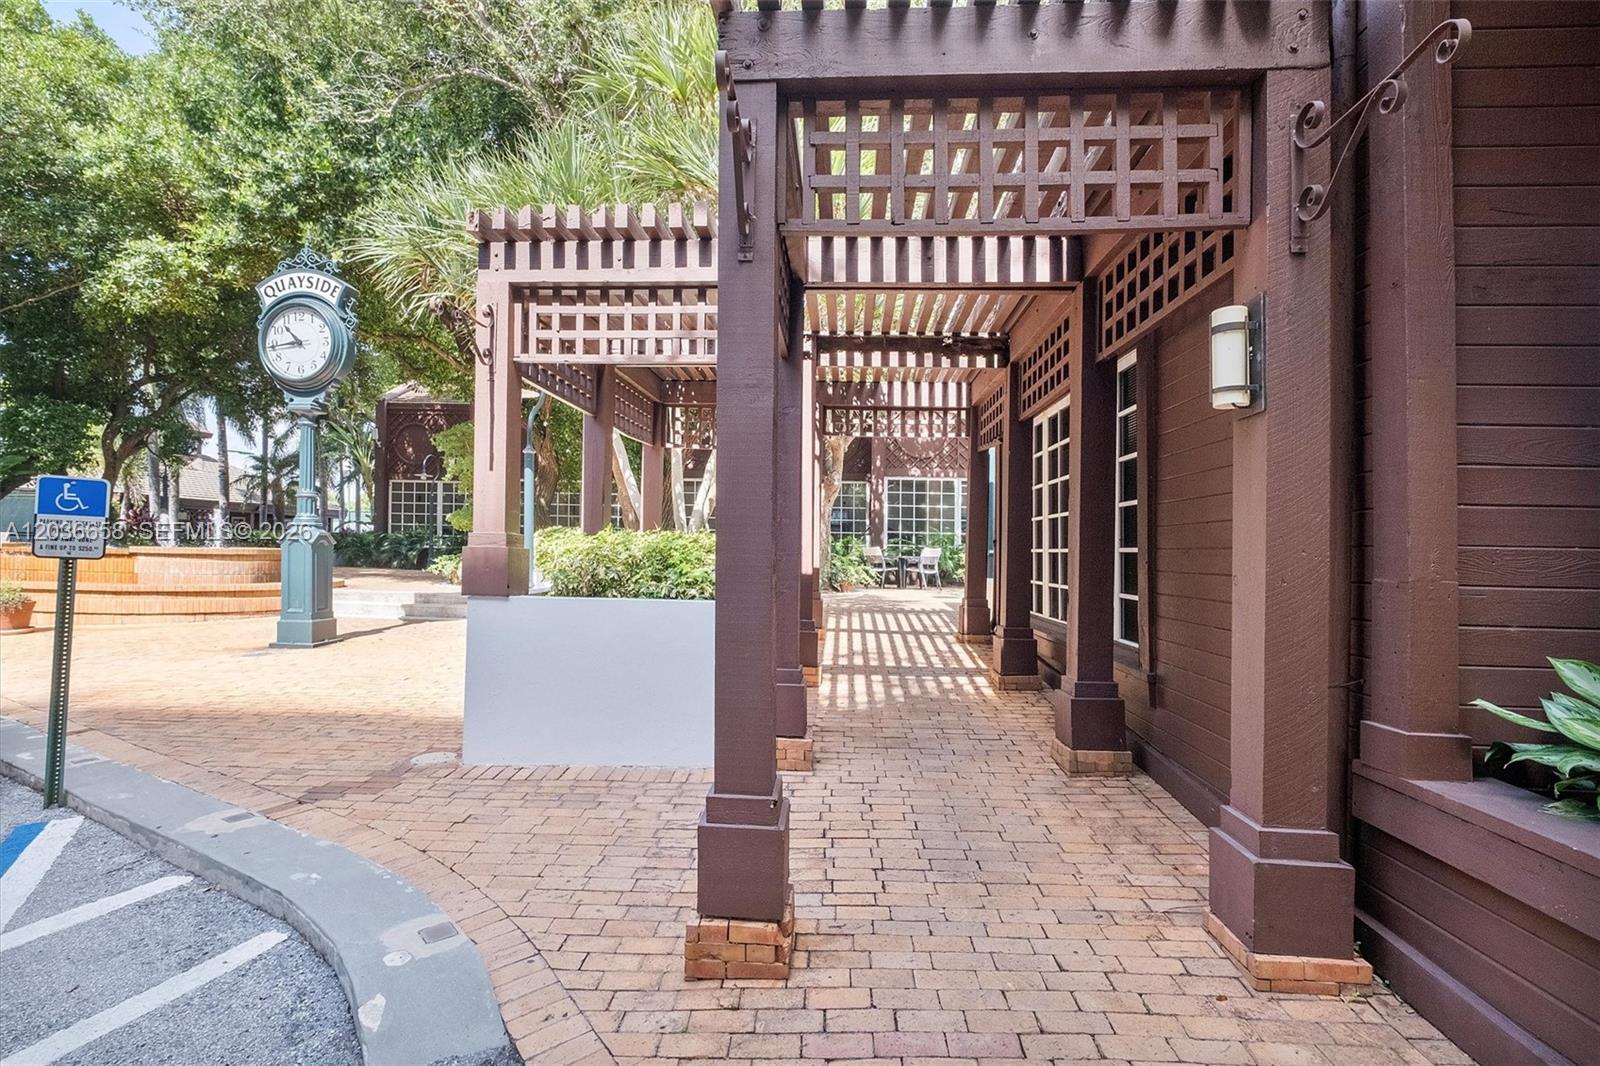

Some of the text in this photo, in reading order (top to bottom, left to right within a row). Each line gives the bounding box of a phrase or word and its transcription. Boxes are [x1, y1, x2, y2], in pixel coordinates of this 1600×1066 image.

[263, 275, 340, 298] QUAYSIDE
[294, 312, 305, 322] 12
[272, 326, 284, 336] 10
[319, 324, 326, 333] 2
[297, 364, 305, 374] 6
